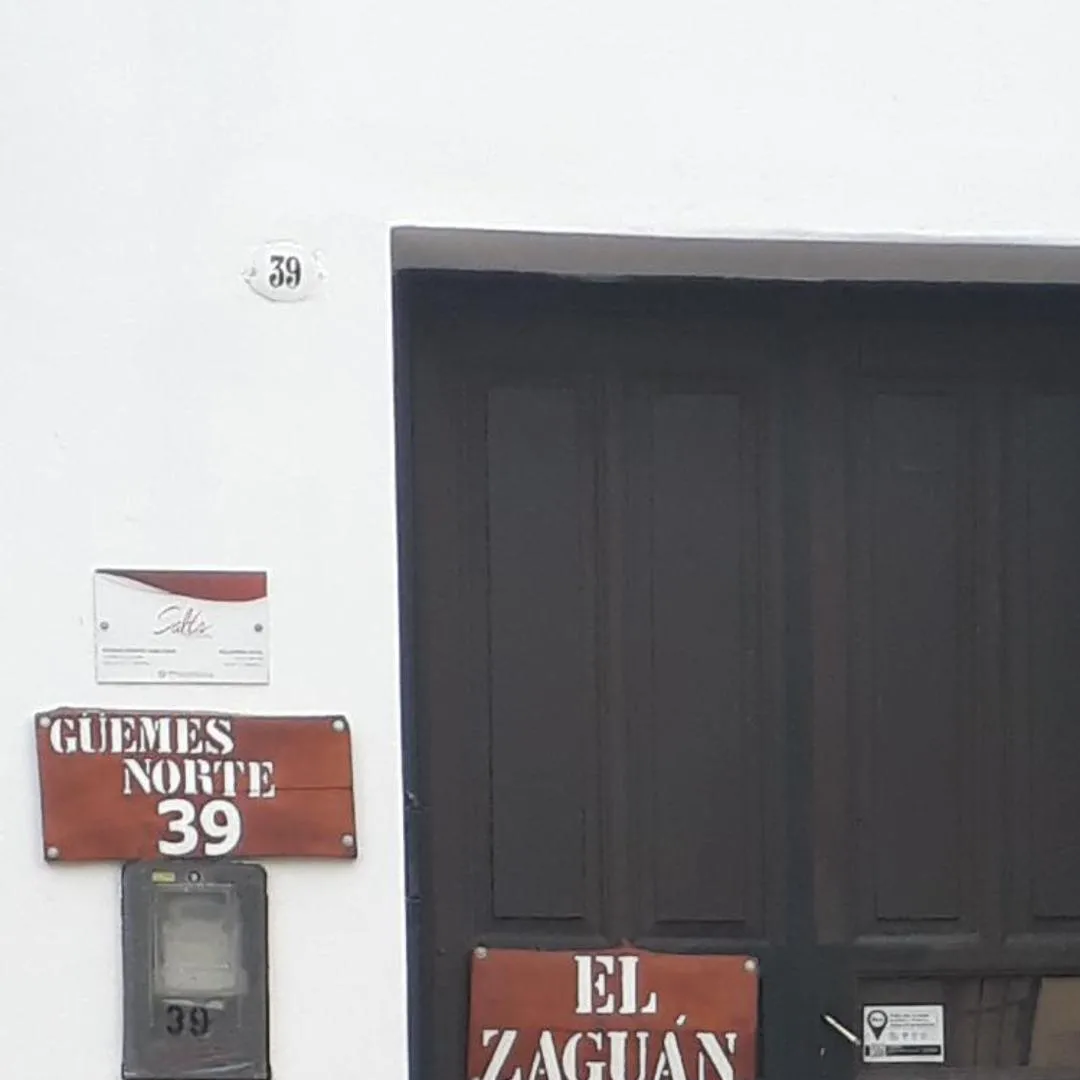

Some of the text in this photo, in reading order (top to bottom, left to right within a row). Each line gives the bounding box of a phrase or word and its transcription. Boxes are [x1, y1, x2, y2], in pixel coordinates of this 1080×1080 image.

[269, 255, 301, 289] 39
[49, 712, 235, 754] GÜEMES
[122, 758, 275, 798] NORTE
[157, 799, 242, 857] 39
[574, 955, 657, 1014] EL
[165, 1004, 210, 1037] 39
